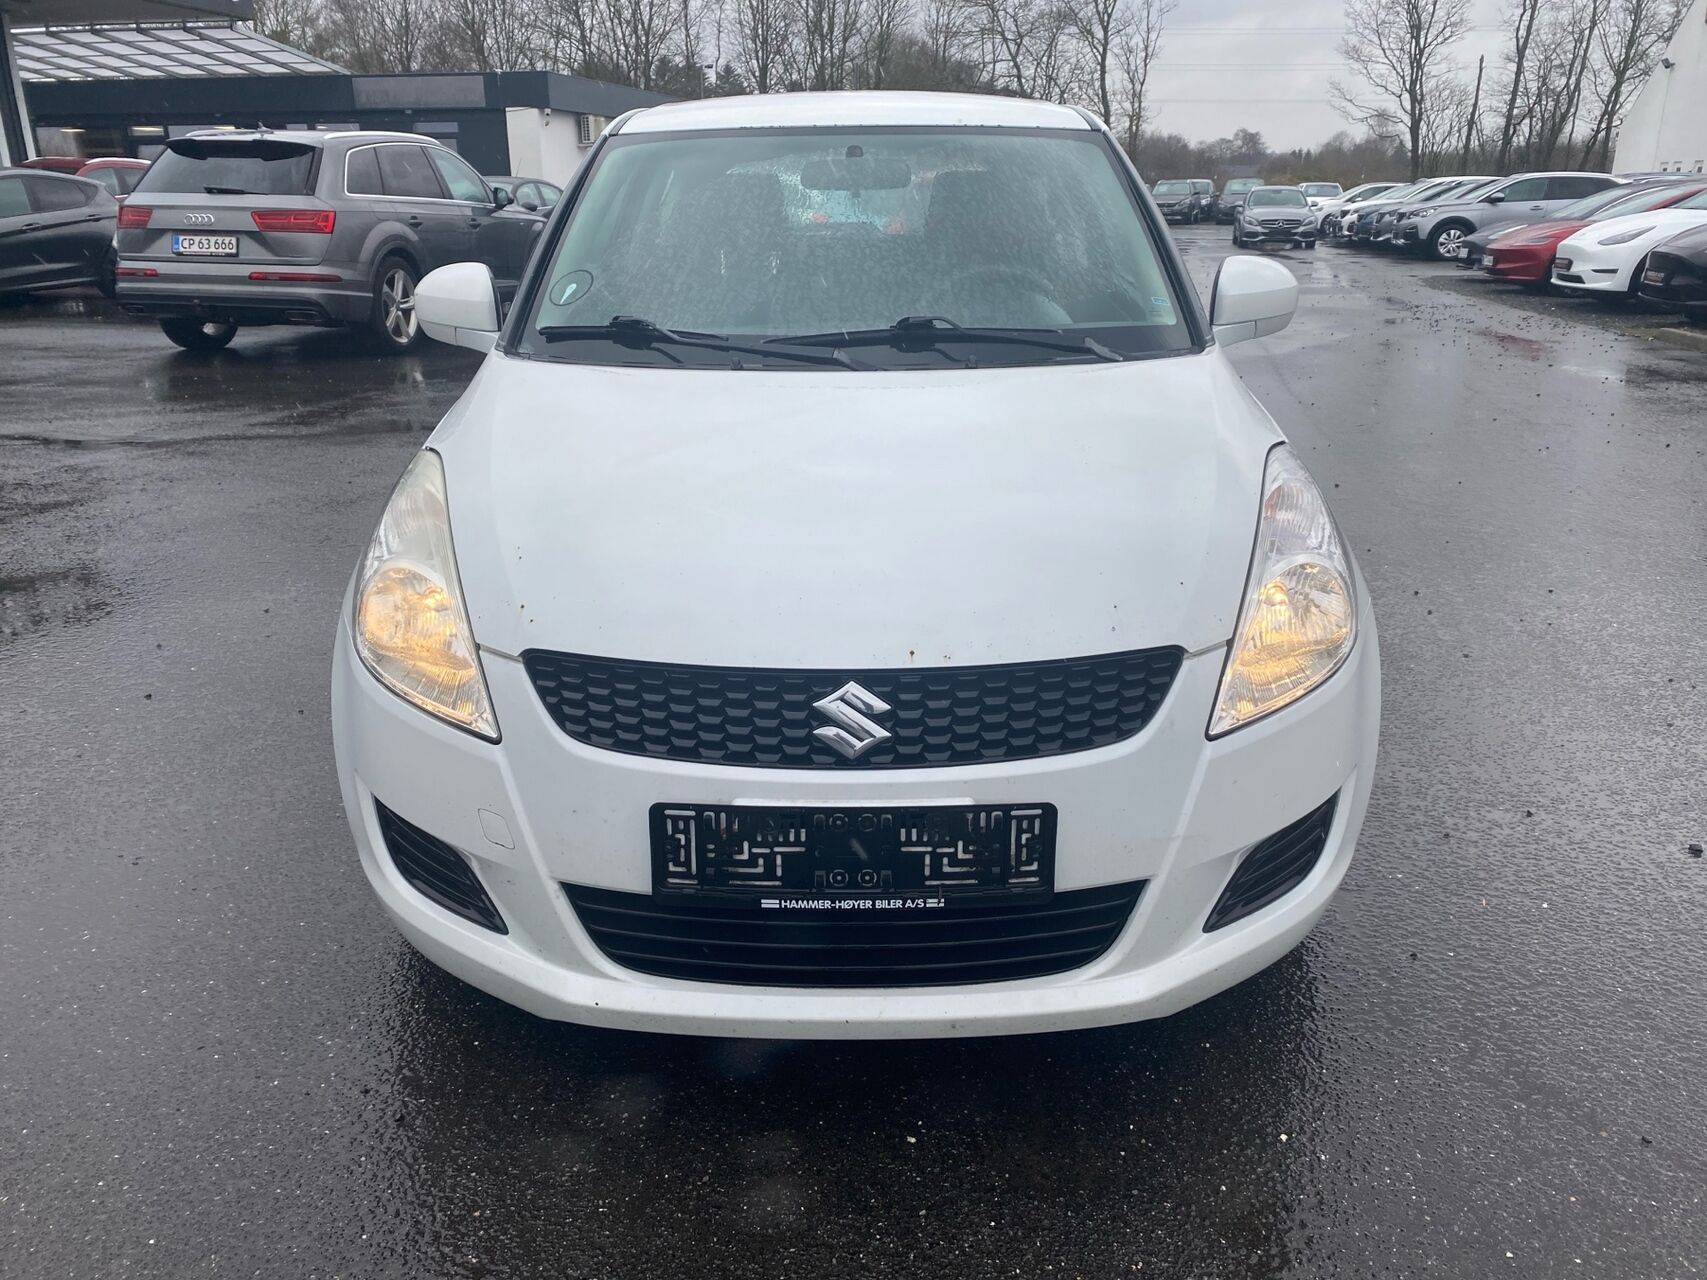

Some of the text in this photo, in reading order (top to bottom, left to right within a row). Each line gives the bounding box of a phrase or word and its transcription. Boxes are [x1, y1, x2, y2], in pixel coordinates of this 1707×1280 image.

[181, 238, 234, 250] CP 63 666
[781, 898, 925, 909] HAMMER-HØYER BILER A/S
